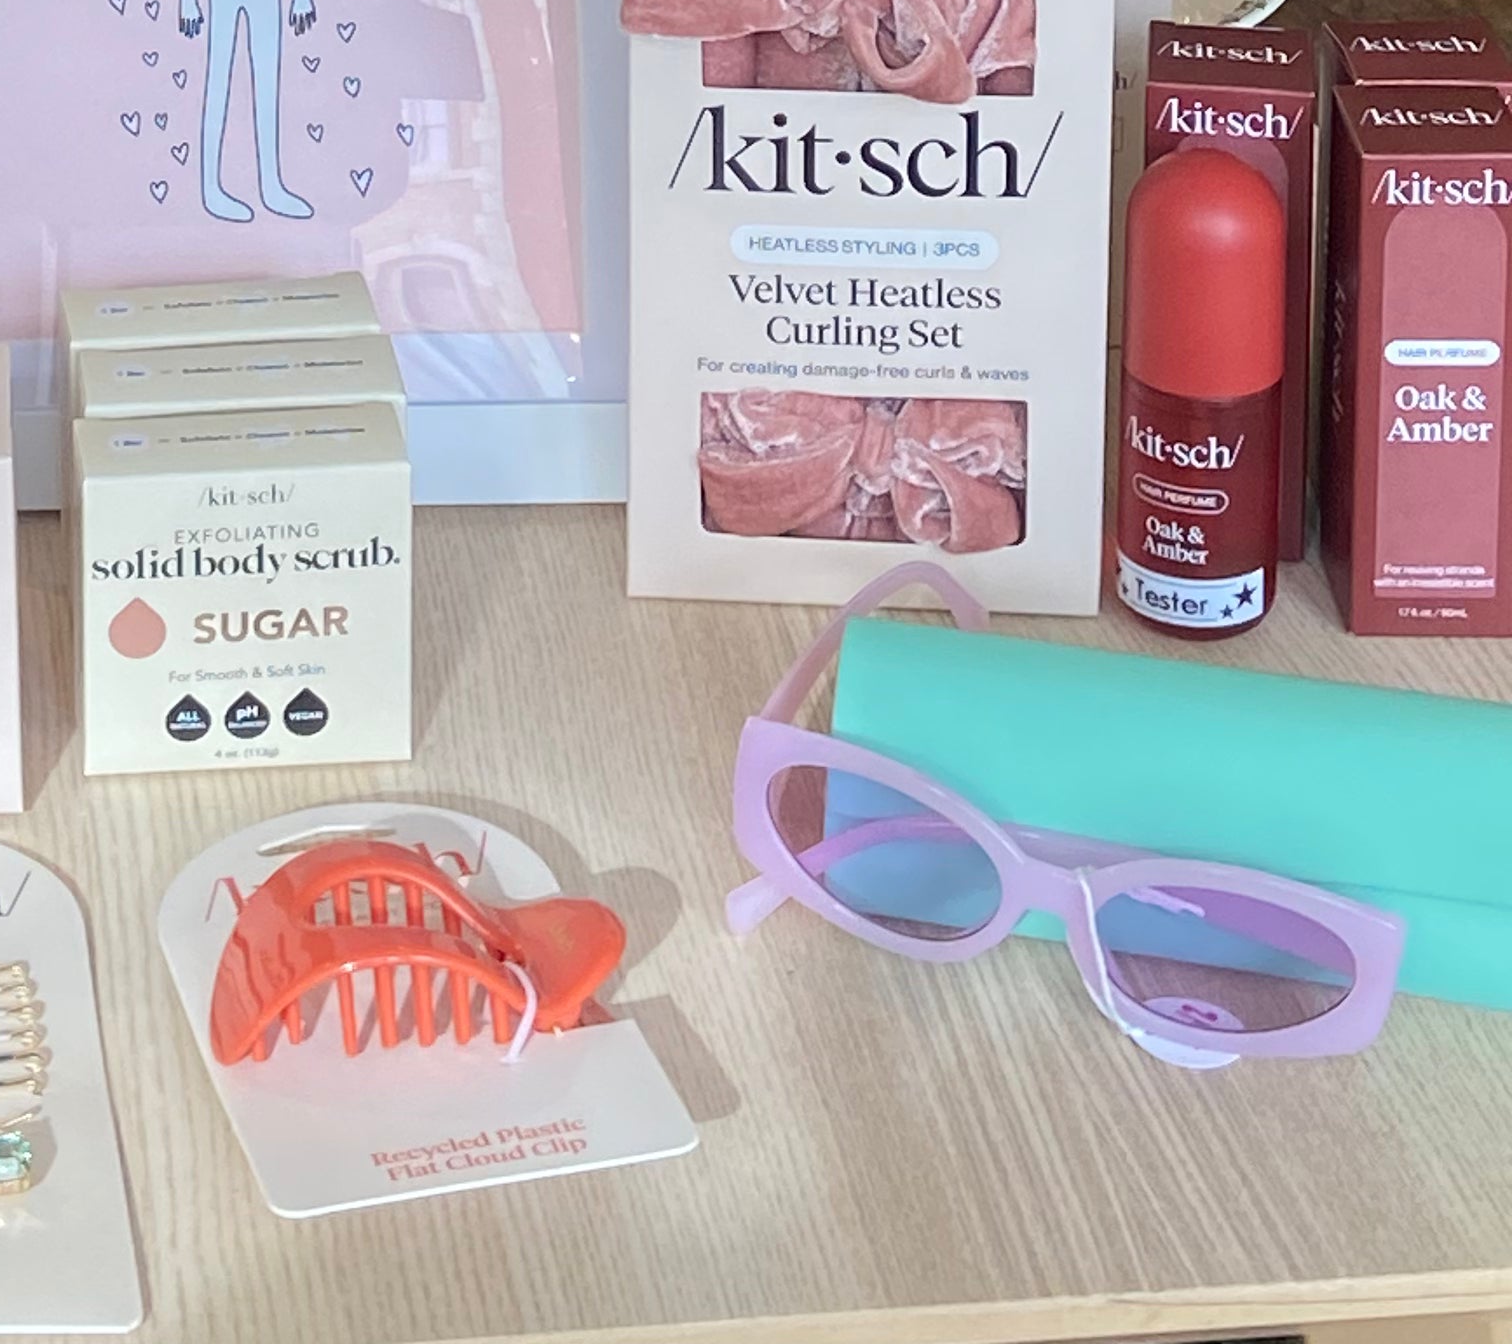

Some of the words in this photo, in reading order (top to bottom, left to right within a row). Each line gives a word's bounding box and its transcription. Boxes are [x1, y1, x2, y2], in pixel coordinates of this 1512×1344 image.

[748, 236, 839, 254] HEATLESS
[841, 239, 917, 256] STYLING
[728, 273, 838, 308] Velvet
[847, 277, 1003, 310] Heatless
[765, 315, 901, 354] Curling
[907, 319, 965, 349] Set
[697, 357, 725, 373] For
[730, 359, 799, 378] creating
[802, 362, 911, 381] damage-free
[914, 365, 956, 380] curls
[960, 366, 974, 380] &
[976, 368, 1030, 381] waves
[1394, 384, 1456, 413] Oak
[1461, 386, 1487, 412] &
[1386, 417, 1494, 444] Amber
[174, 522, 320, 546] EXFOLIATING
[1144, 515, 1185, 543] Oak
[1187, 525, 1206, 545] &
[91, 544, 185, 582] solid
[193, 543, 288, 584] body
[294, 535, 401, 572] scrub.
[1142, 534, 1210, 566] Amber
[1134, 576, 1209, 617] Tester
[192, 606, 349, 645] SUGAR
[168, 670, 191, 685] For
[194, 666, 248, 683] Smooth
[251, 665, 264, 679] &
[266, 663, 294, 679] Soft
[297, 662, 326, 676] Skin
[236, 705, 259, 721] pH
[370, 1134, 492, 1168] Recycled
[496, 1117, 587, 1147] Plastic
[387, 1158, 440, 1182] Flat
[444, 1147, 526, 1172] Cloud
[531, 1136, 588, 1163] Clip
